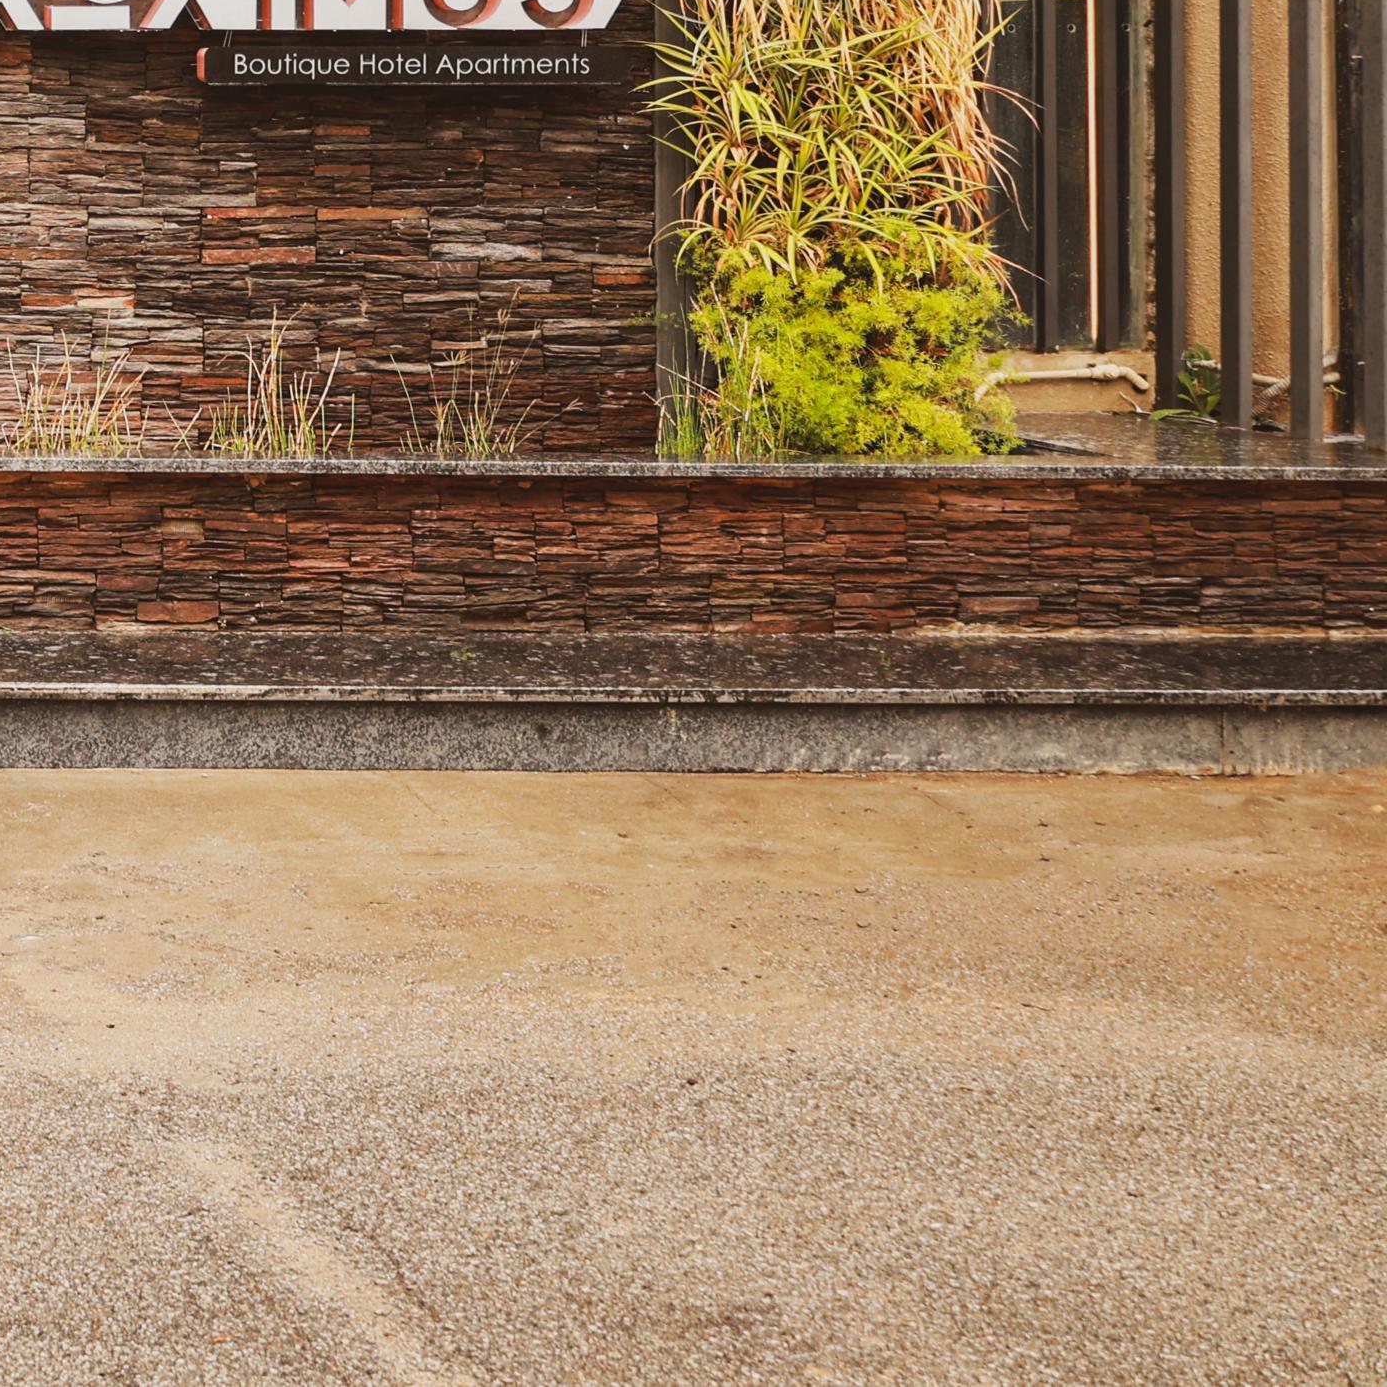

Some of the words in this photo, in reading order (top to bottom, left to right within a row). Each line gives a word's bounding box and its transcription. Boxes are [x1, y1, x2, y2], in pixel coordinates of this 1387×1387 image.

[233, 53, 351, 80] Boutique
[359, 53, 427, 75] Hotel
[435, 53, 590, 80] Apartments
